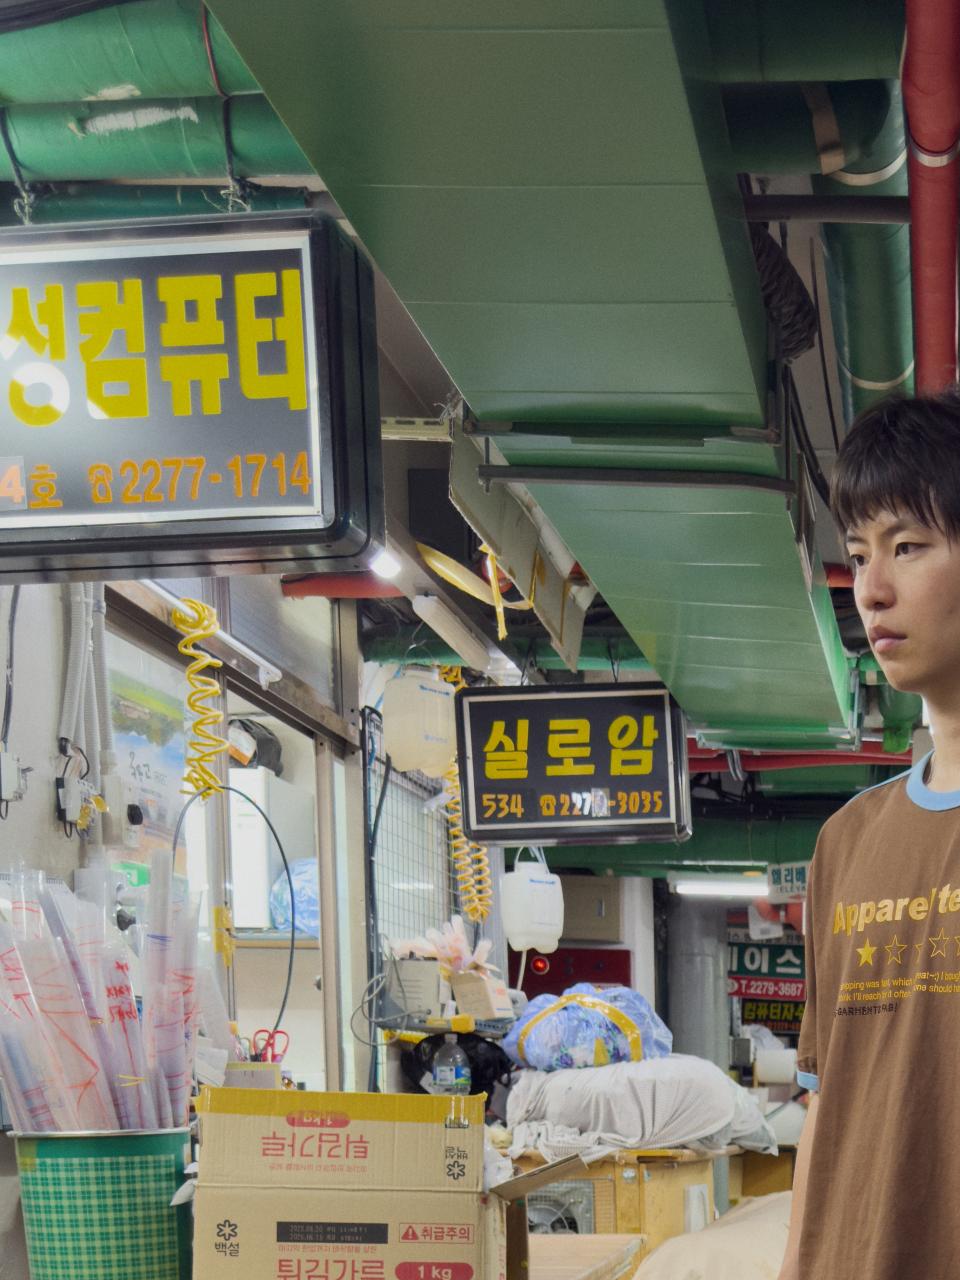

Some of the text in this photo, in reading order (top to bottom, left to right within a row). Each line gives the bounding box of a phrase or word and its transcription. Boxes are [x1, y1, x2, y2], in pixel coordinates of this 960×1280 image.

[119, 452, 311, 504] 2277-1714
[483, 714, 659, 780] 실로암
[482, 794, 524, 819] 534
[261, 1131, 370, 1160] 튀김가루
[421, 1225, 471, 1242] 취급주의
[214, 1241, 240, 1257] 백설
